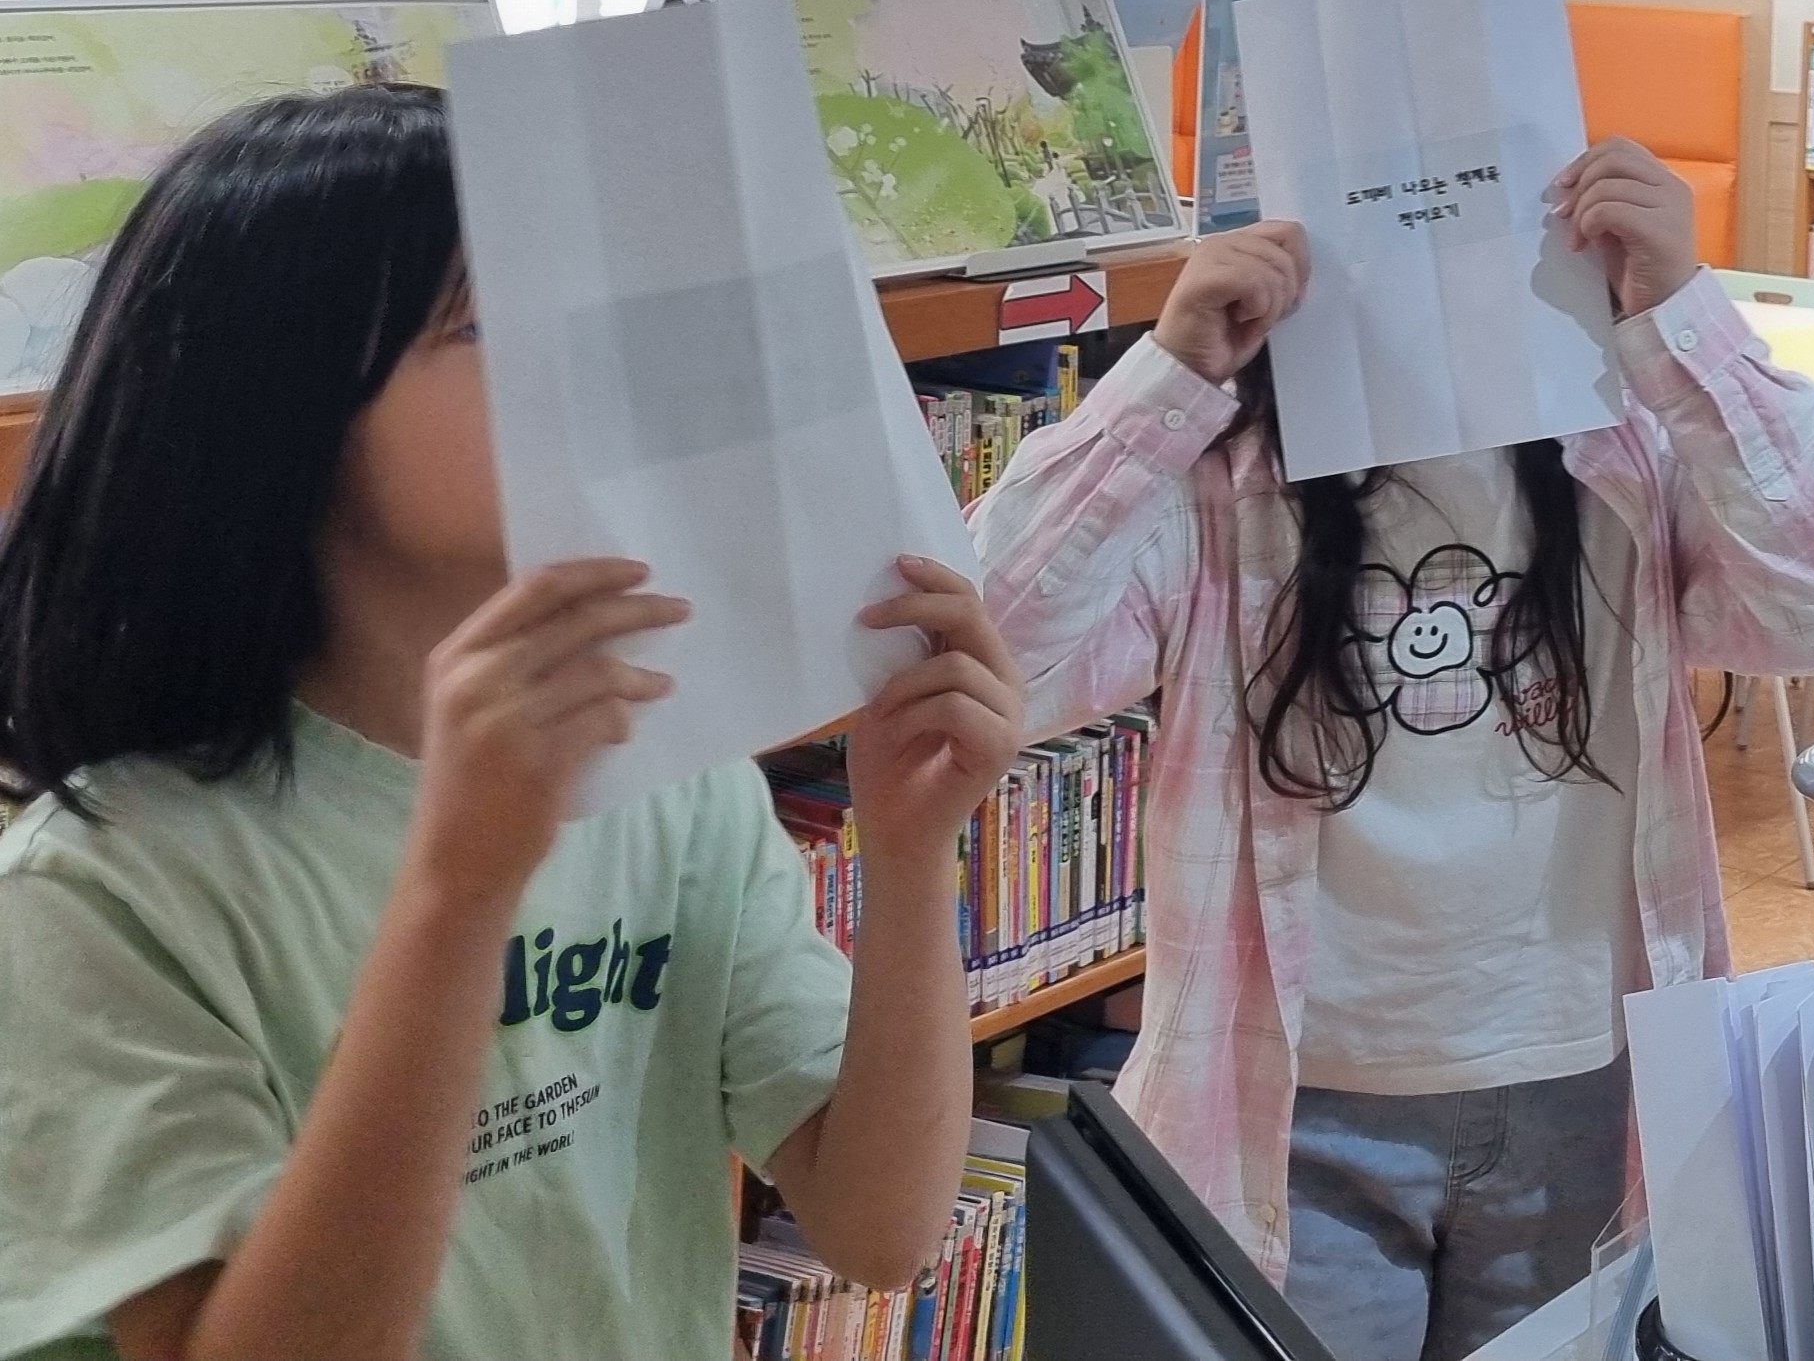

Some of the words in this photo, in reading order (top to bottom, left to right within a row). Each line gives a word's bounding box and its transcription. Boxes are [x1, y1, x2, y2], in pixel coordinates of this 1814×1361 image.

[1346, 185, 1393, 206] 도깨비
[1400, 176, 1449, 196] 나오는
[1454, 165, 1502, 189] 책제목
[499, 917, 672, 1032] light
[494, 1095, 520, 1121] THE
[524, 1073, 579, 1110] GARDEN
[495, 1117, 532, 1144] FACE
[537, 1108, 558, 1130] TO
[560, 1097, 582, 1120] THE
[578, 1084, 602, 1107] SUN
[463, 1161, 495, 1186] IGHT
[495, 1156, 510, 1175] IN
[513, 1146, 534, 1167] THE
